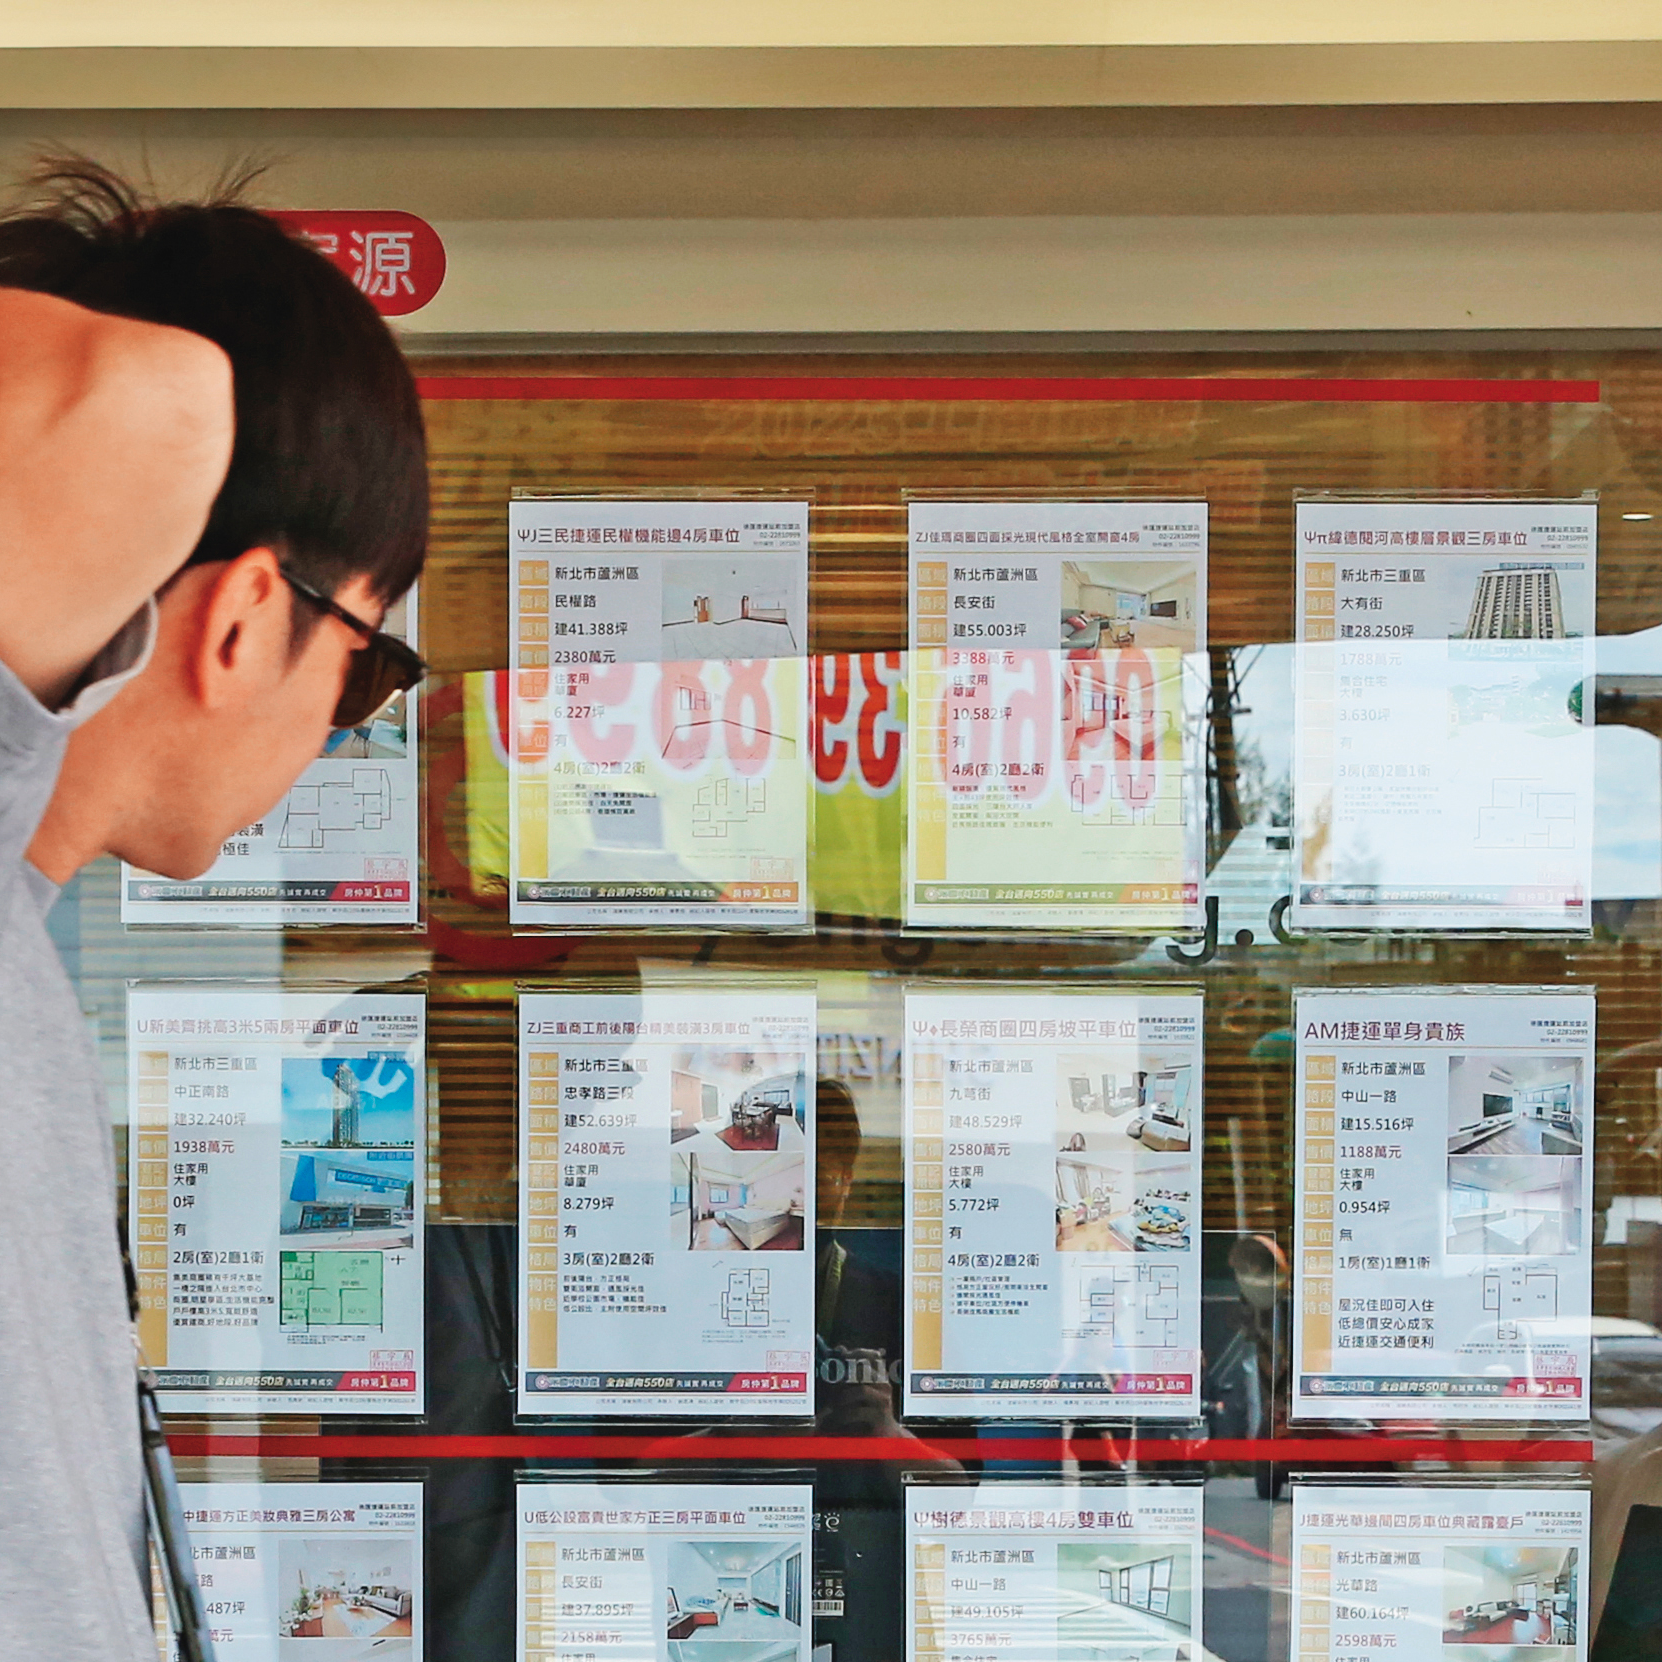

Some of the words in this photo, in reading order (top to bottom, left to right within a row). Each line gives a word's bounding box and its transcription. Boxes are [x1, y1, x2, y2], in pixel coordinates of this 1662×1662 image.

[555, 594, 596, 608] 民權路
[953, 596, 995, 609] 長安街
[1340, 597, 1382, 610] 大有街
[953, 623, 1027, 637] 建55.003坪
[554, 650, 616, 663] 2380萬元
[1304, 1022, 1465, 1041] AM捷運單身貴族
[564, 1086, 634, 1100] 忠孝路三段
[1341, 1090, 1397, 1103] 中山一路
[174, 1140, 235, 1154] 1938萬元
[564, 1141, 625, 1155] 2480萬元
[949, 1142, 1011, 1156] 2580萬元
[1340, 1145, 1402, 1159] 1188萬元
[1338, 1298, 1434, 1312] 屋況佳即可入住
[183, 1509, 355, 1523] 中捷運方正美妝典雅三房公寓
[561, 1575, 602, 1589] 長安街
[951, 1578, 1006, 1591] 中山一路
[1336, 1578, 1378, 1592] 光華路
[1335, 1634, 1397, 1648] 2598萬元
